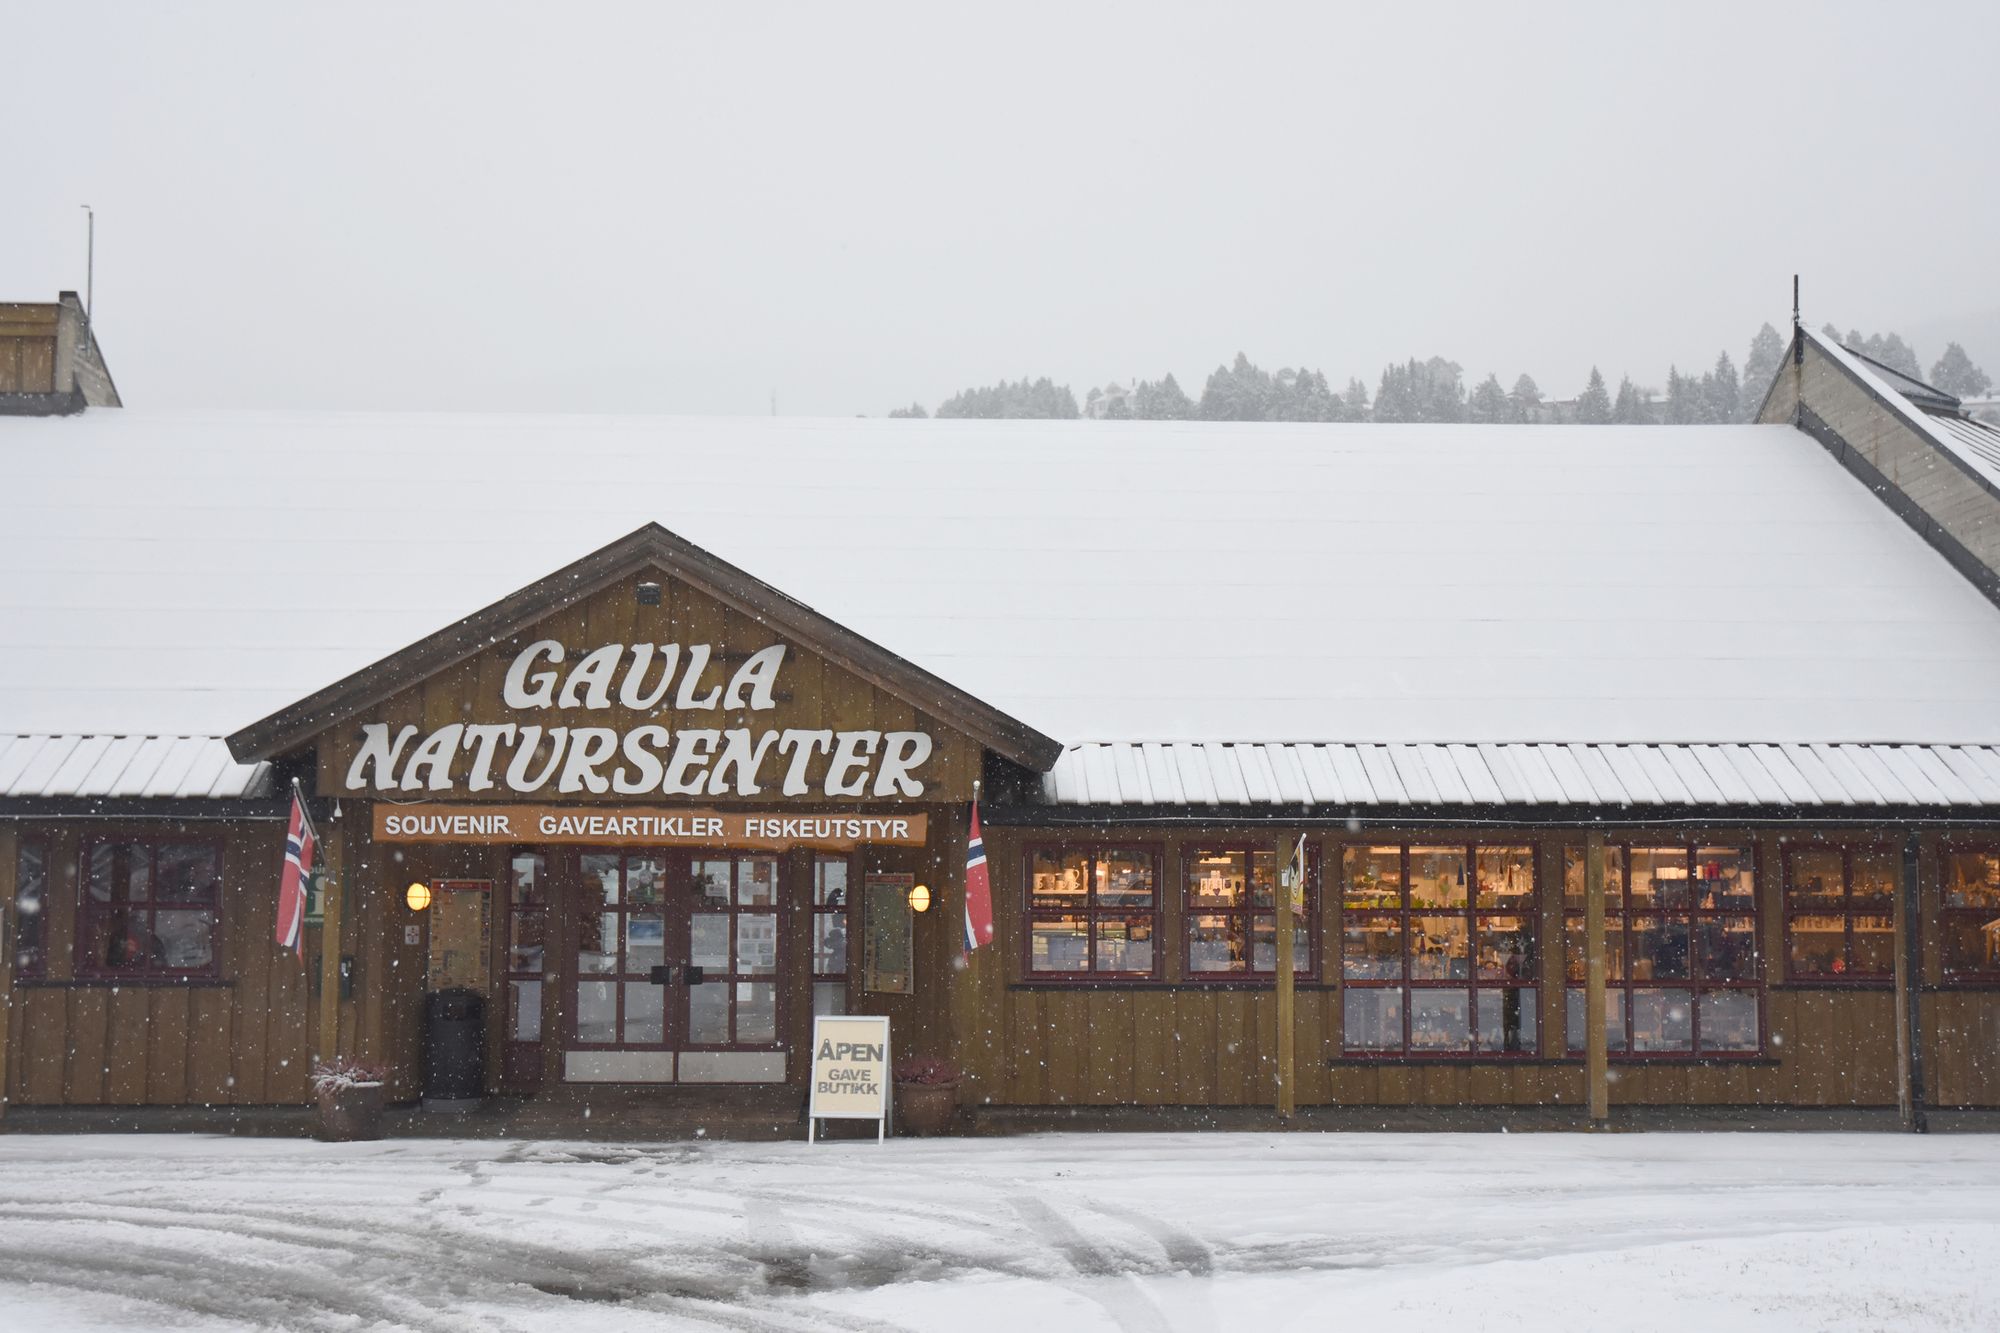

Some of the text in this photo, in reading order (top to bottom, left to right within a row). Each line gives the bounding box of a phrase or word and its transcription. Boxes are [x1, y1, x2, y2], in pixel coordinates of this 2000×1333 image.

[503, 639, 786, 711] GAULA
[346, 722, 933, 797] NATURSENTER
[385, 815, 909, 838] SOUVENIR GAVEARTIKLER FISKEUTSTYR
[816, 1038, 884, 1062] ÅPEN
[828, 1069, 871, 1081] GAVE
[817, 1081, 879, 1095] BUTIKK
